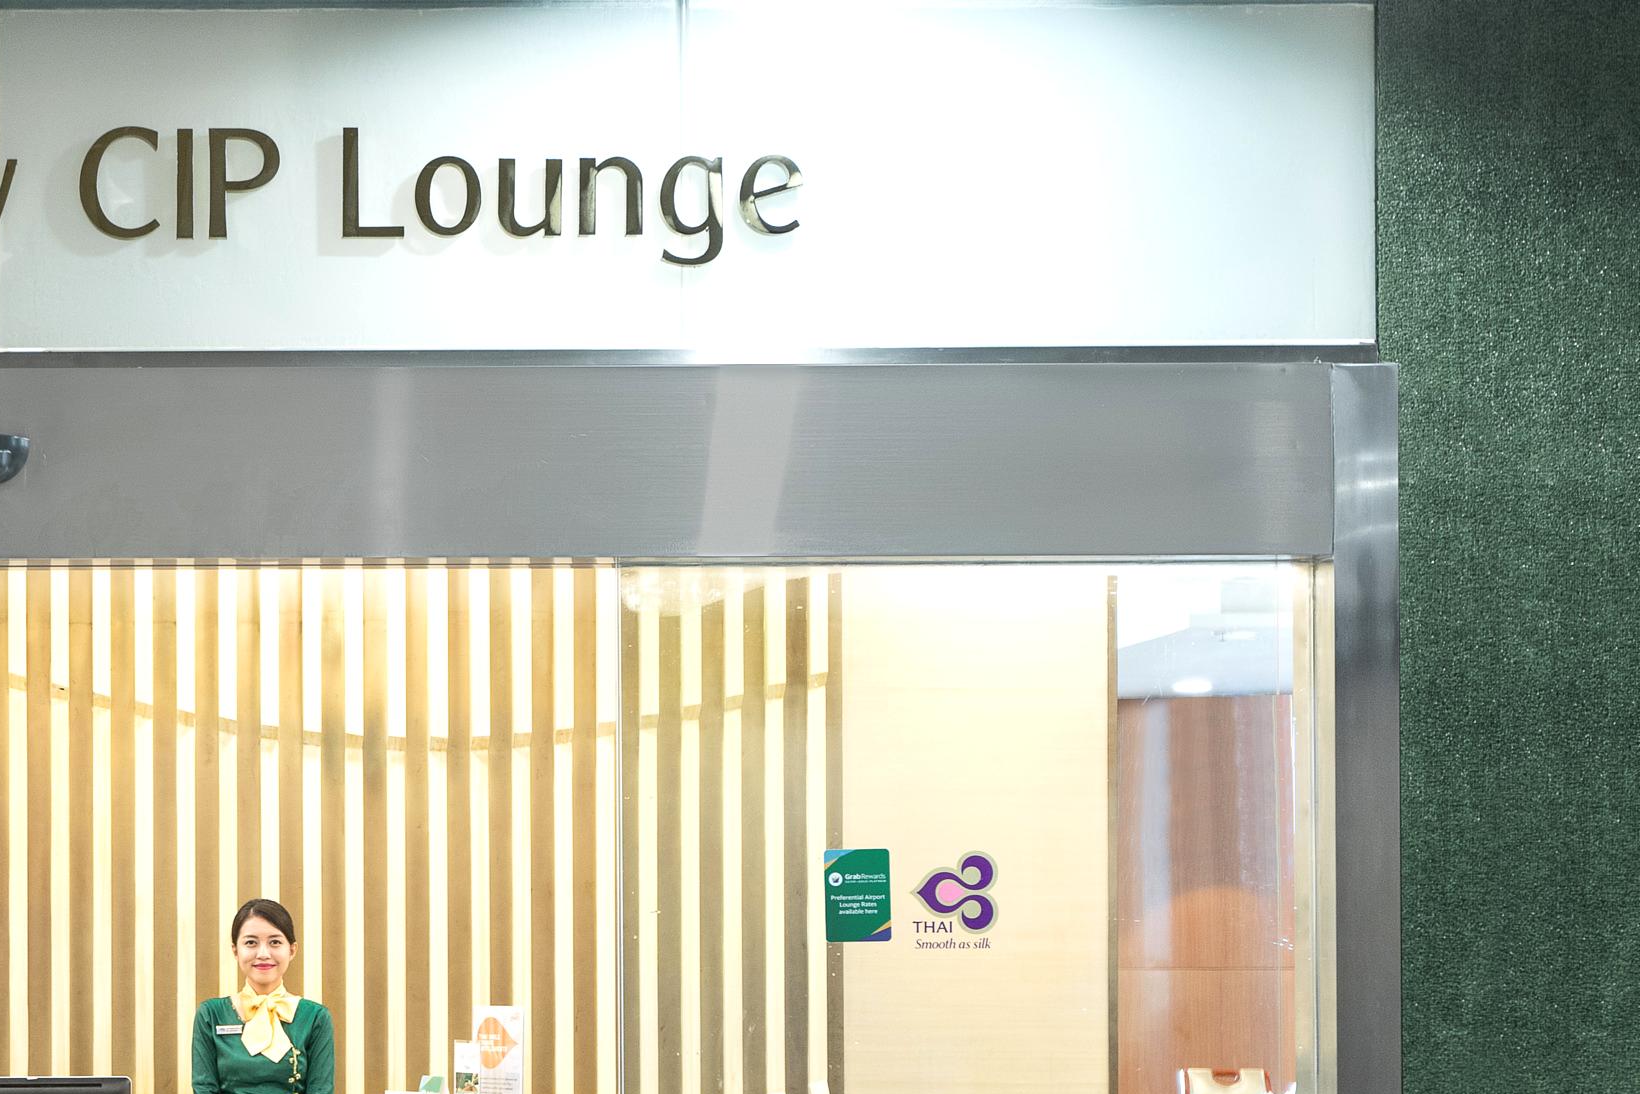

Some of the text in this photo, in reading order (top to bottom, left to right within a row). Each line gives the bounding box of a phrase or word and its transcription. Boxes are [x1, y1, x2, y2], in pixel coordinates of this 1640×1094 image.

[79, 126, 281, 241] CIP
[342, 127, 804, 266] Lounge
[839, 901, 861, 909] Lounge
[912, 921, 953, 933] THAI
[914, 937, 992, 950] Smooth as silk
